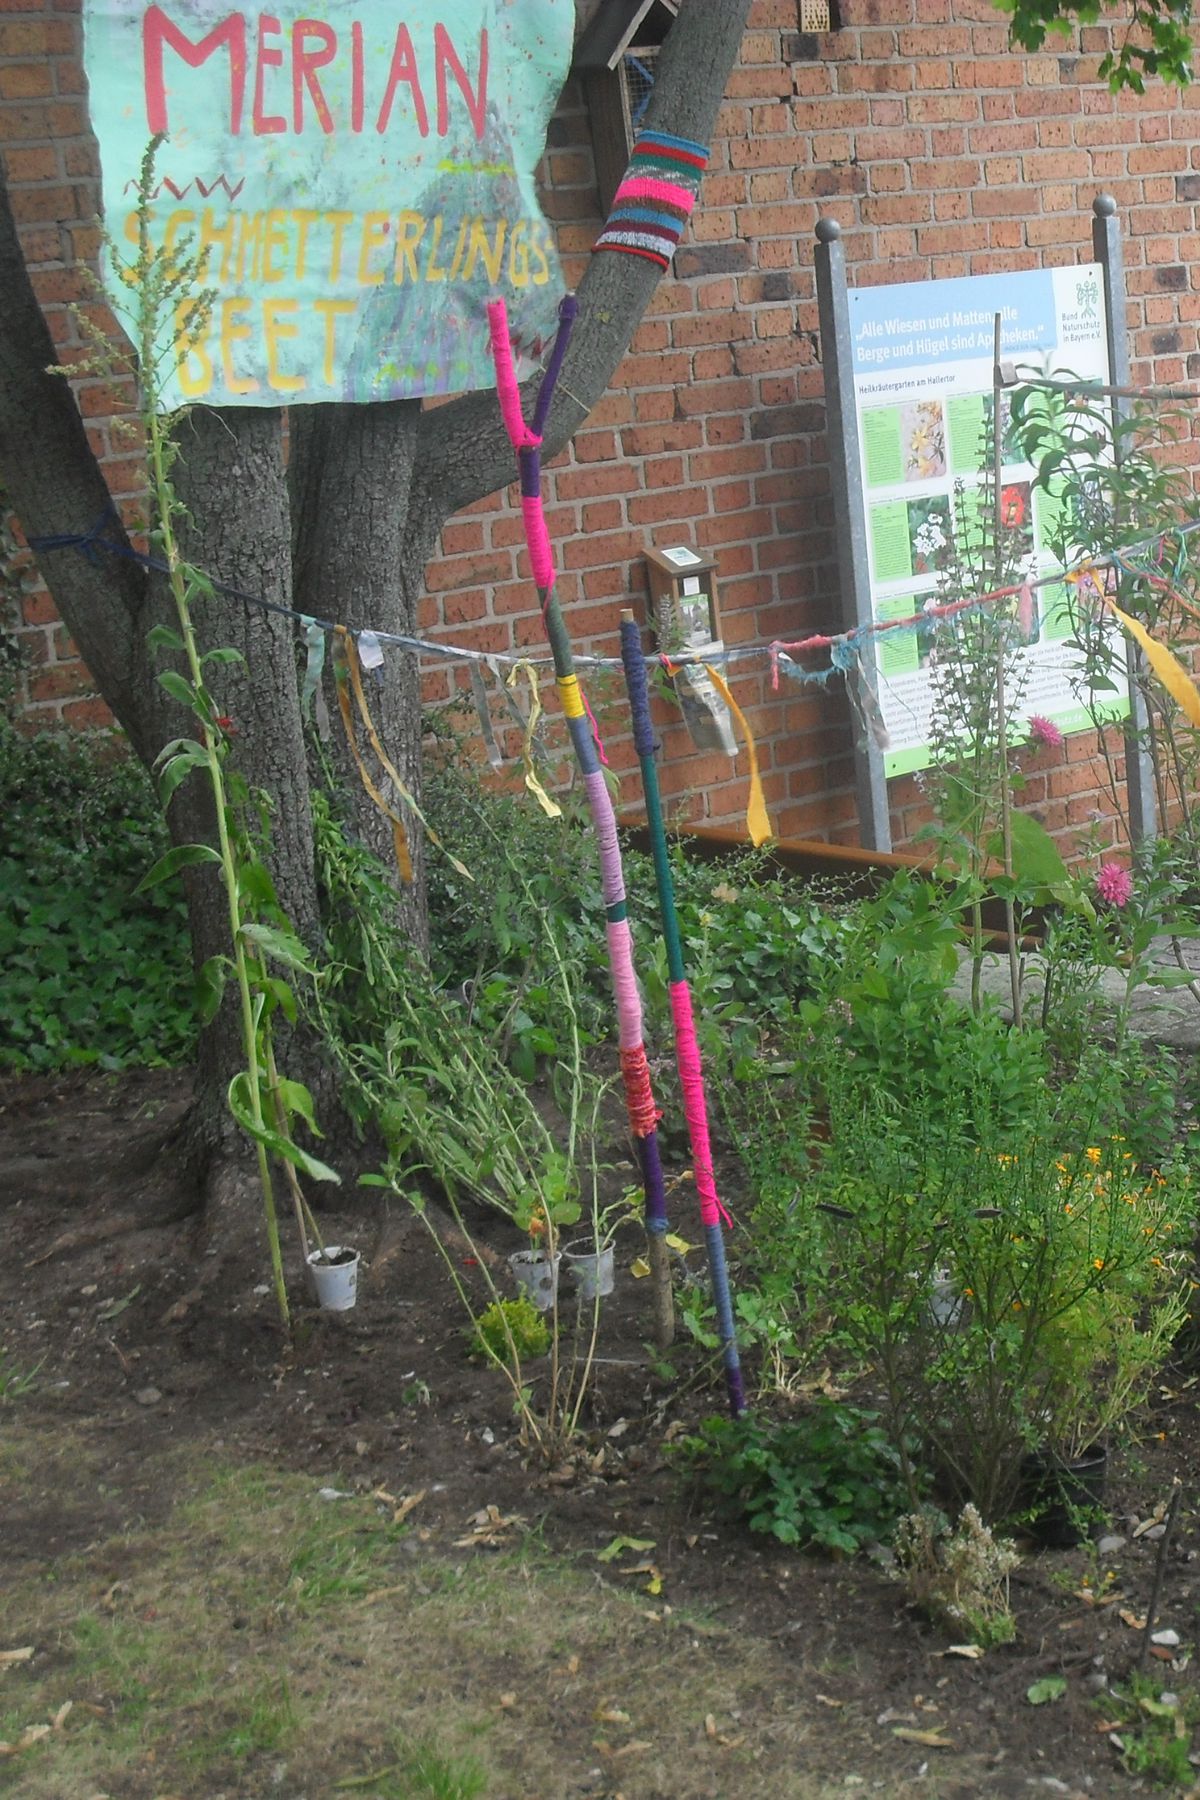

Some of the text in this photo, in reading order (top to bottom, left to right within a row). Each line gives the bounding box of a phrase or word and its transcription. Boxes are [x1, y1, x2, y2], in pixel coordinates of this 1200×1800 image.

[143, 4, 489, 138] MERIAN
[884, 317, 926, 335] Wiesen
[928, 312, 950, 329] und
[173, 296, 358, 396] BEET
[857, 346, 890, 363] Berge
[892, 341, 913, 357] und
[916, 335, 949, 356] Hügel
[951, 332, 975, 350] sind
[859, 380, 915, 394] Heilkräutergarten
